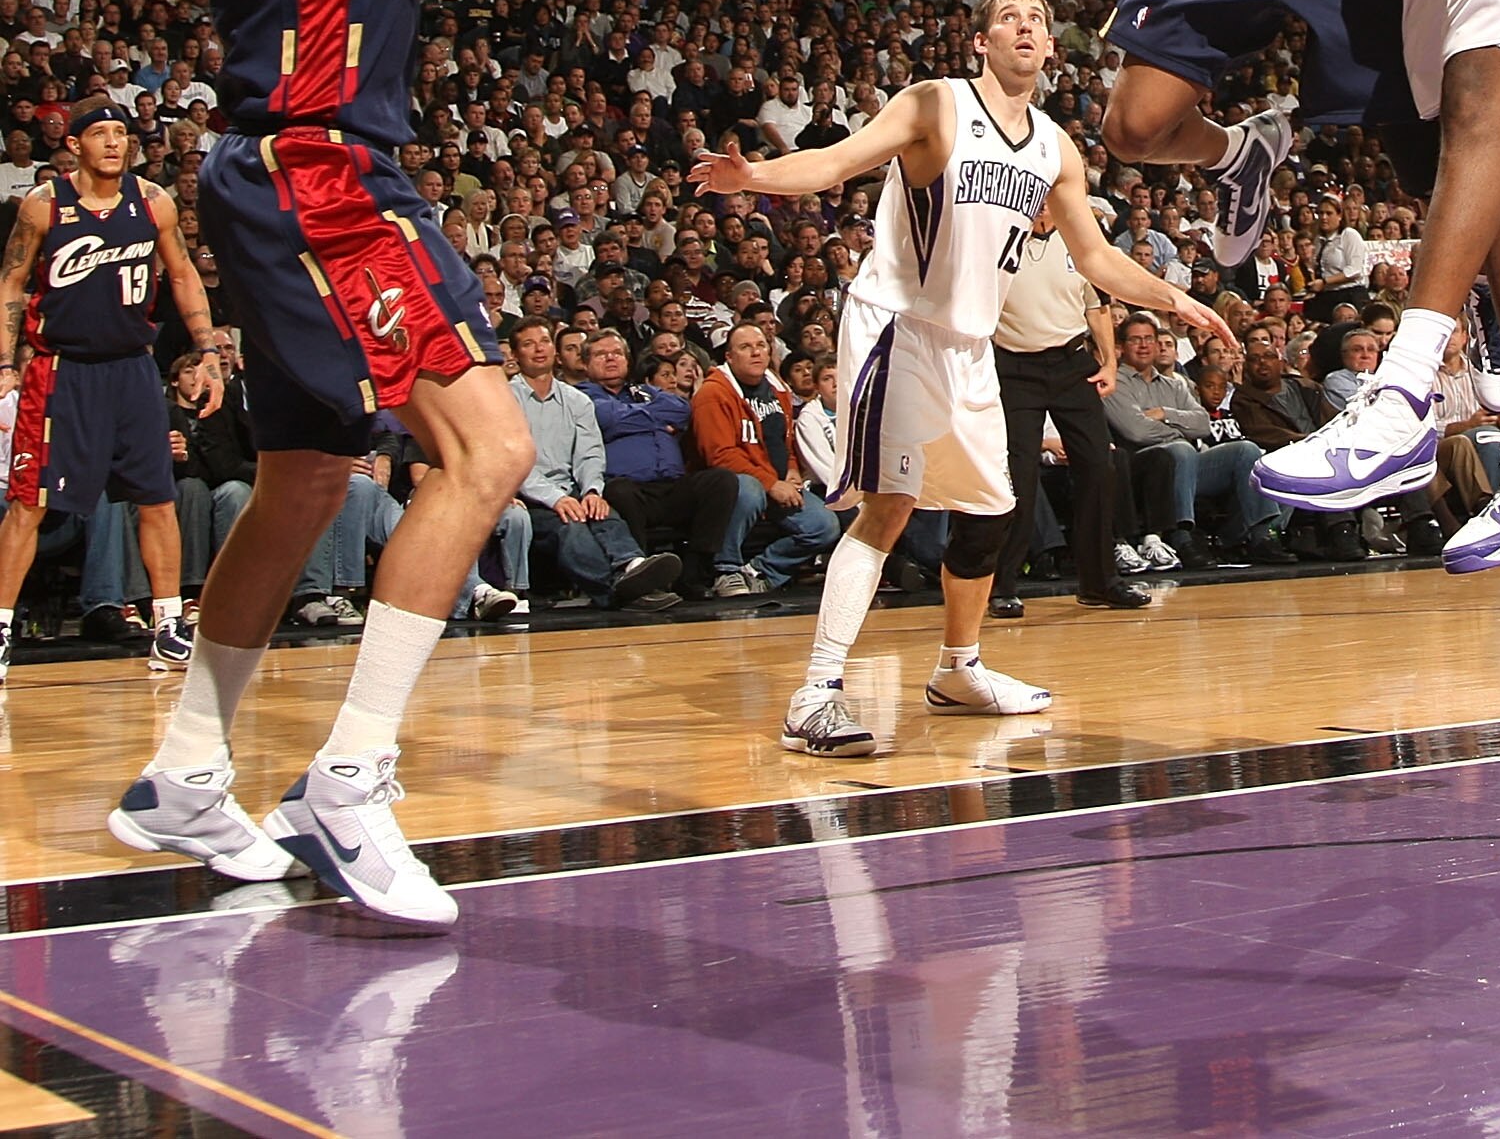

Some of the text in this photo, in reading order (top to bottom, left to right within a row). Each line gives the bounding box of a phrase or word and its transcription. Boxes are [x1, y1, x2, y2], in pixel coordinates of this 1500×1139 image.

[955, 160, 1053, 221] SACRAMENT
[50, 235, 155, 289] CLEVELAND
[118, 264, 149, 306] 13
